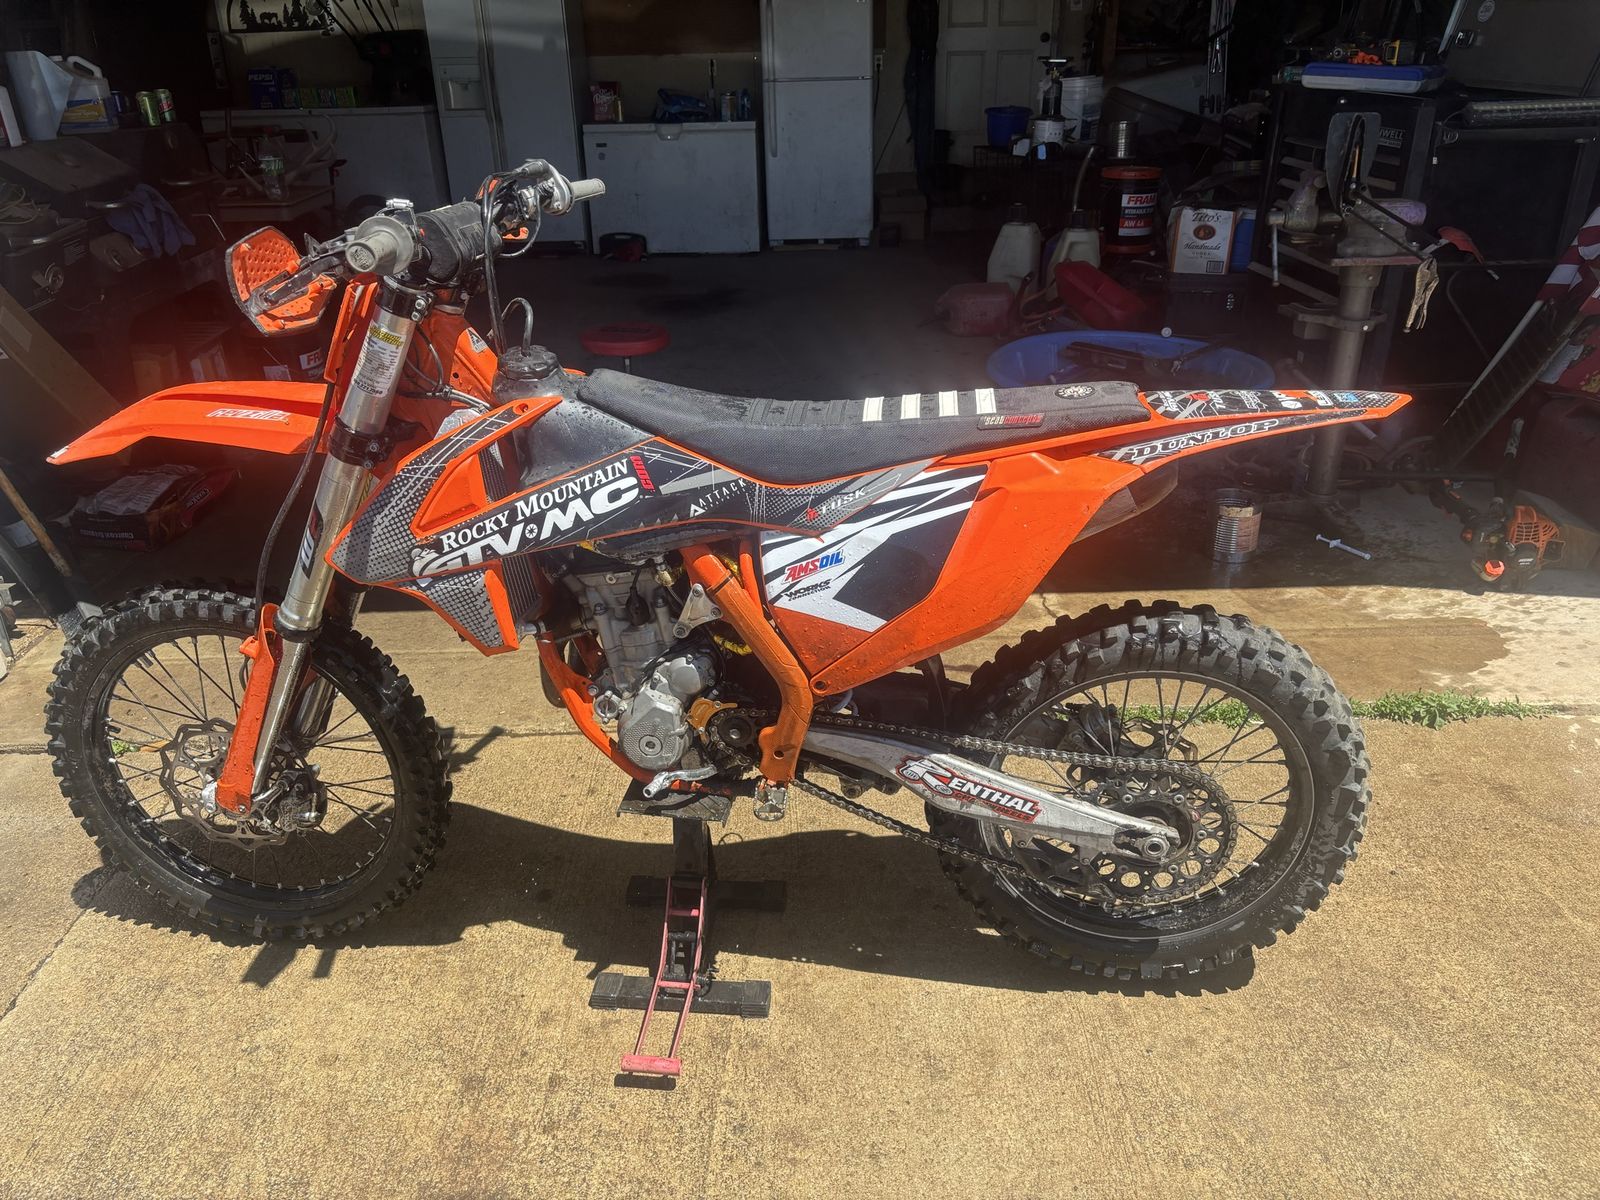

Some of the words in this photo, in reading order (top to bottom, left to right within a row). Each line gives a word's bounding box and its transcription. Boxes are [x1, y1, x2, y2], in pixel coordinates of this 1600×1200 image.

[1131, 419, 1280, 461] DUNLOP
[440, 512, 511, 554] ROCKY
[515, 457, 629, 521] MOUNTAIN
[698, 477, 747, 508] ATTACK
[821, 486, 866, 514] TUSK
[783, 550, 845, 583] AMSOIL
[783, 578, 832, 598] WORKS
